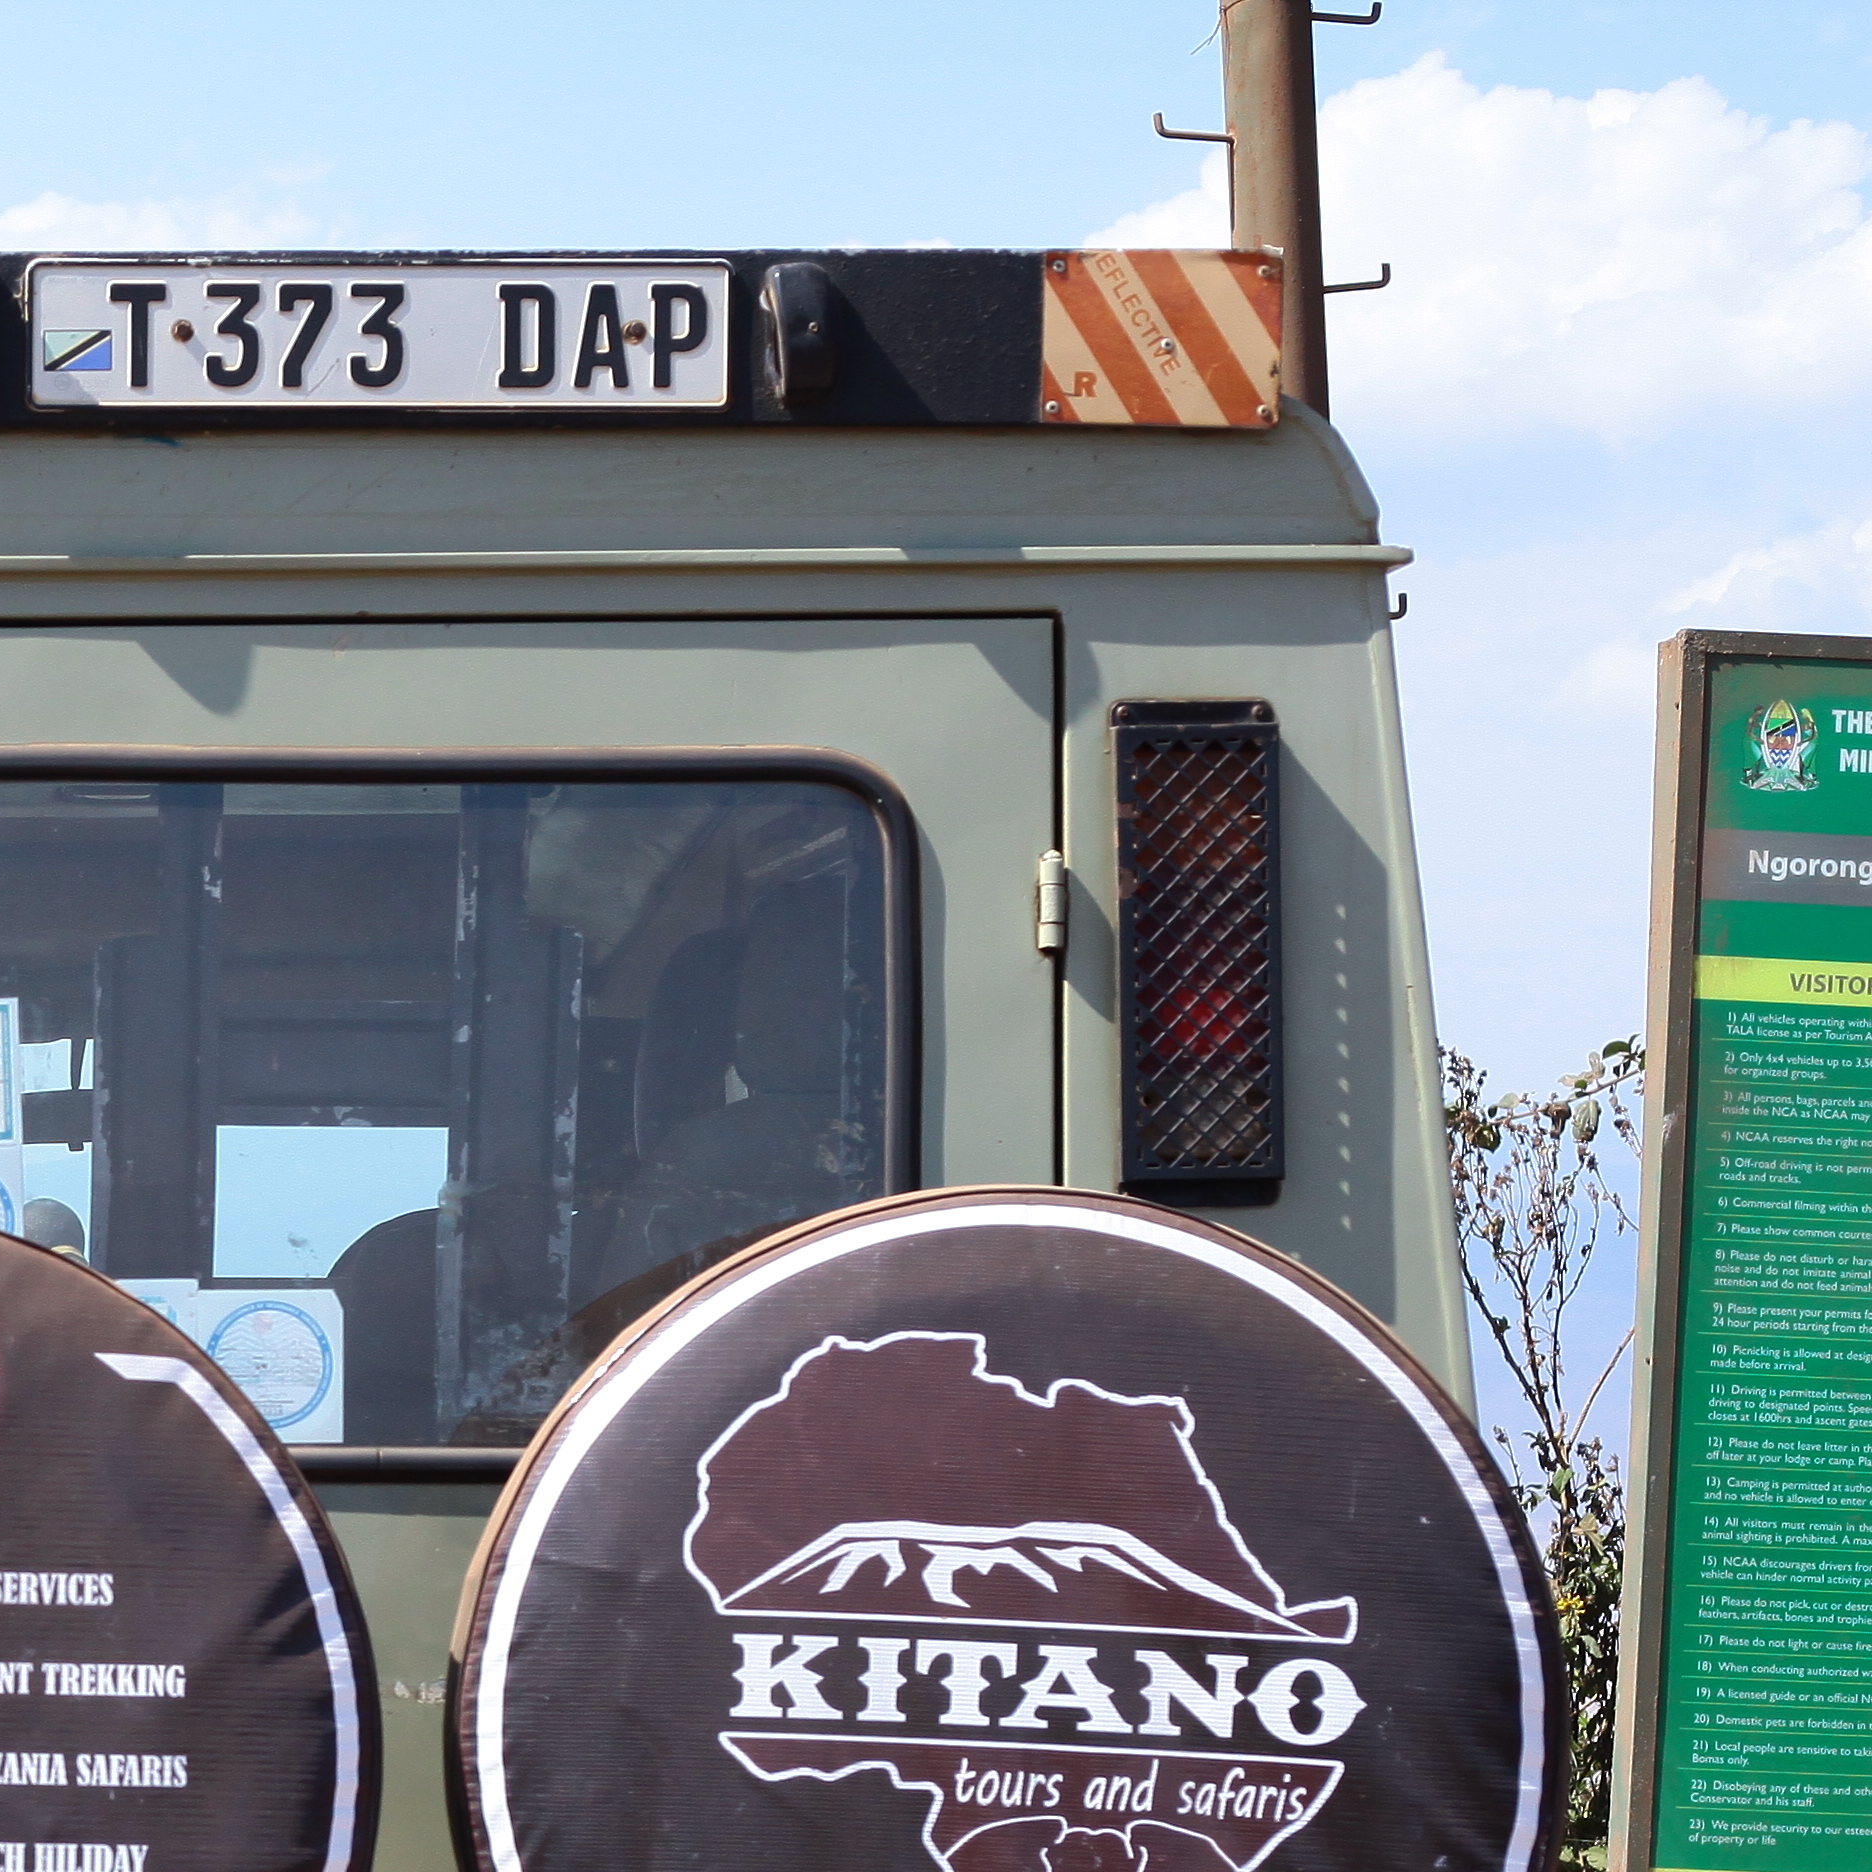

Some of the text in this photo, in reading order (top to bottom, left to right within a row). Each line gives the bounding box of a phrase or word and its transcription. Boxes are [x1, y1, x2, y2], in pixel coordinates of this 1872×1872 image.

[1095, 253, 1182, 376] EFLECTIVE
[109, 280, 709, 389] T 373 DAP
[1074, 371, 1098, 397] R
[1839, 748, 1872, 773] MI
[1741, 1012, 1755, 1024] All
[1758, 1013, 1795, 1025] vehicles
[1798, 1015, 1845, 1029] operating
[1727, 1025, 1863, 1041] TALA license as per Tourism
[1739, 1052, 1764, 1065] Only
[1765, 1053, 1785, 1064] 4x4
[1786, 1054, 1824, 1066] vehicles
[1826, 1058, 1840, 1068] up
[1841, 1056, 1853, 1067] to
[1724, 1065, 1738, 1076] for
[1741, 1065, 1788, 1080] organized
[1737, 1091, 1752, 1102] All
[1821, 1095, 1856, 1109] parcels
[1722, 1104, 1870, 1122] inside the NCA as NCAA may
[1735, 1131, 1770, 1143] NCAA
[1772, 1135, 1814, 1145] reserves
[1816, 1134, 1833, 1146] the
[1835, 1135, 1858, 1149] right
[1732, 1197, 1792, 1210] Commercial
[1794, 1199, 1826, 1213] filming
[1828, 1201, 1858, 1212] within
[1731, 1223, 1762, 1235] Please
[1764, 1225, 1790, 1236] show
[1792, 1228, 1836, 1238] common
[1727, 1304, 1757, 1316] Please
[1760, 1305, 1797, 1319] present
[1799, 1309, 1822, 1320] your
[1824, 1308, 1862, 1322] permits
[1712, 1317, 1856, 1334] 24 hour periods starting from
[1733, 1345, 1780, 1360] Picnicking
[1783, 1347, 1790, 1358] is
[1794, 1347, 1831, 1360] allowed
[1834, 1349, 1843, 1360] at
[1710, 1357, 1737, 1369] made
[1739, 1358, 1771, 1370] before
[1708, 1410, 1846, 1426] closes at 1600hrs and ascent
[1723, 1556, 1758, 1568] NCAA
[1759, 1557, 1816, 1572] discourages
[1818, 1560, 1852, 1572] drivers
[1700, 1568, 1862, 1587] vehicle can hinder normal activity
[1718, 1661, 1748, 1673] When
[1751, 1662, 1804, 1677] conducting
[1807, 1664, 1859, 1677] authorized
[41, 1662, 187, 1697] TREKKING
[728, 1632, 1368, 1747] KITANO
[1716, 1714, 1762, 1727] Domestic
[1765, 1716, 1786, 1730] pets
[1789, 1720, 1804, 1728] are
[1807, 1718, 1854, 1730] forbidden
[1857, 1720, 1866, 1731] in
[1692, 1753, 1724, 1765] Bomas
[76, 1753, 188, 1788] SAFARIS
[955, 1757, 1308, 1823] tours and safaris
[1690, 1793, 1752, 1806] Conservator
[1755, 1795, 1773, 1807] and
[1775, 1796, 1789, 1807] his
[1711, 1820, 1729, 1831] We
[1731, 1821, 1768, 1835] provide
[1770, 1822, 1809, 1837] security
[1811, 1824, 1822, 1835] to
[1824, 1827, 1842, 1836] our
[1688, 1832, 1776, 1847] of property or life
